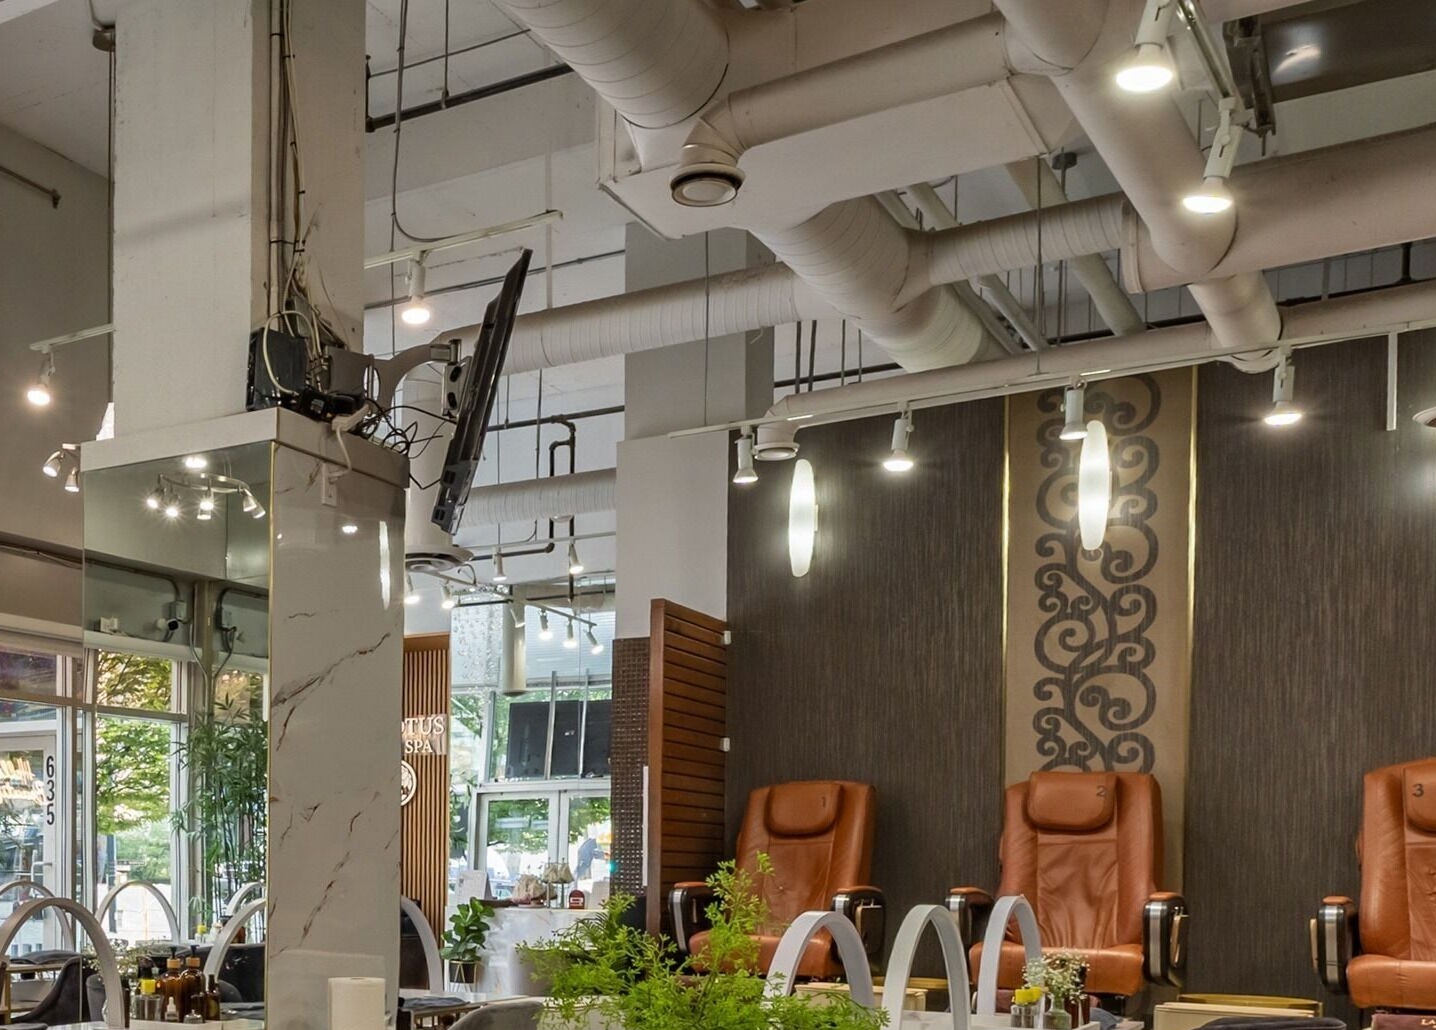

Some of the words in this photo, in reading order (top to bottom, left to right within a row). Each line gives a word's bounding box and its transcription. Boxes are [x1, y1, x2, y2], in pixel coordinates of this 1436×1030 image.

[405, 739, 433, 754] SPA
[46, 755, 55, 825] 635
[1096, 784, 1107, 798] 2
[1412, 783, 1425, 798] 3
